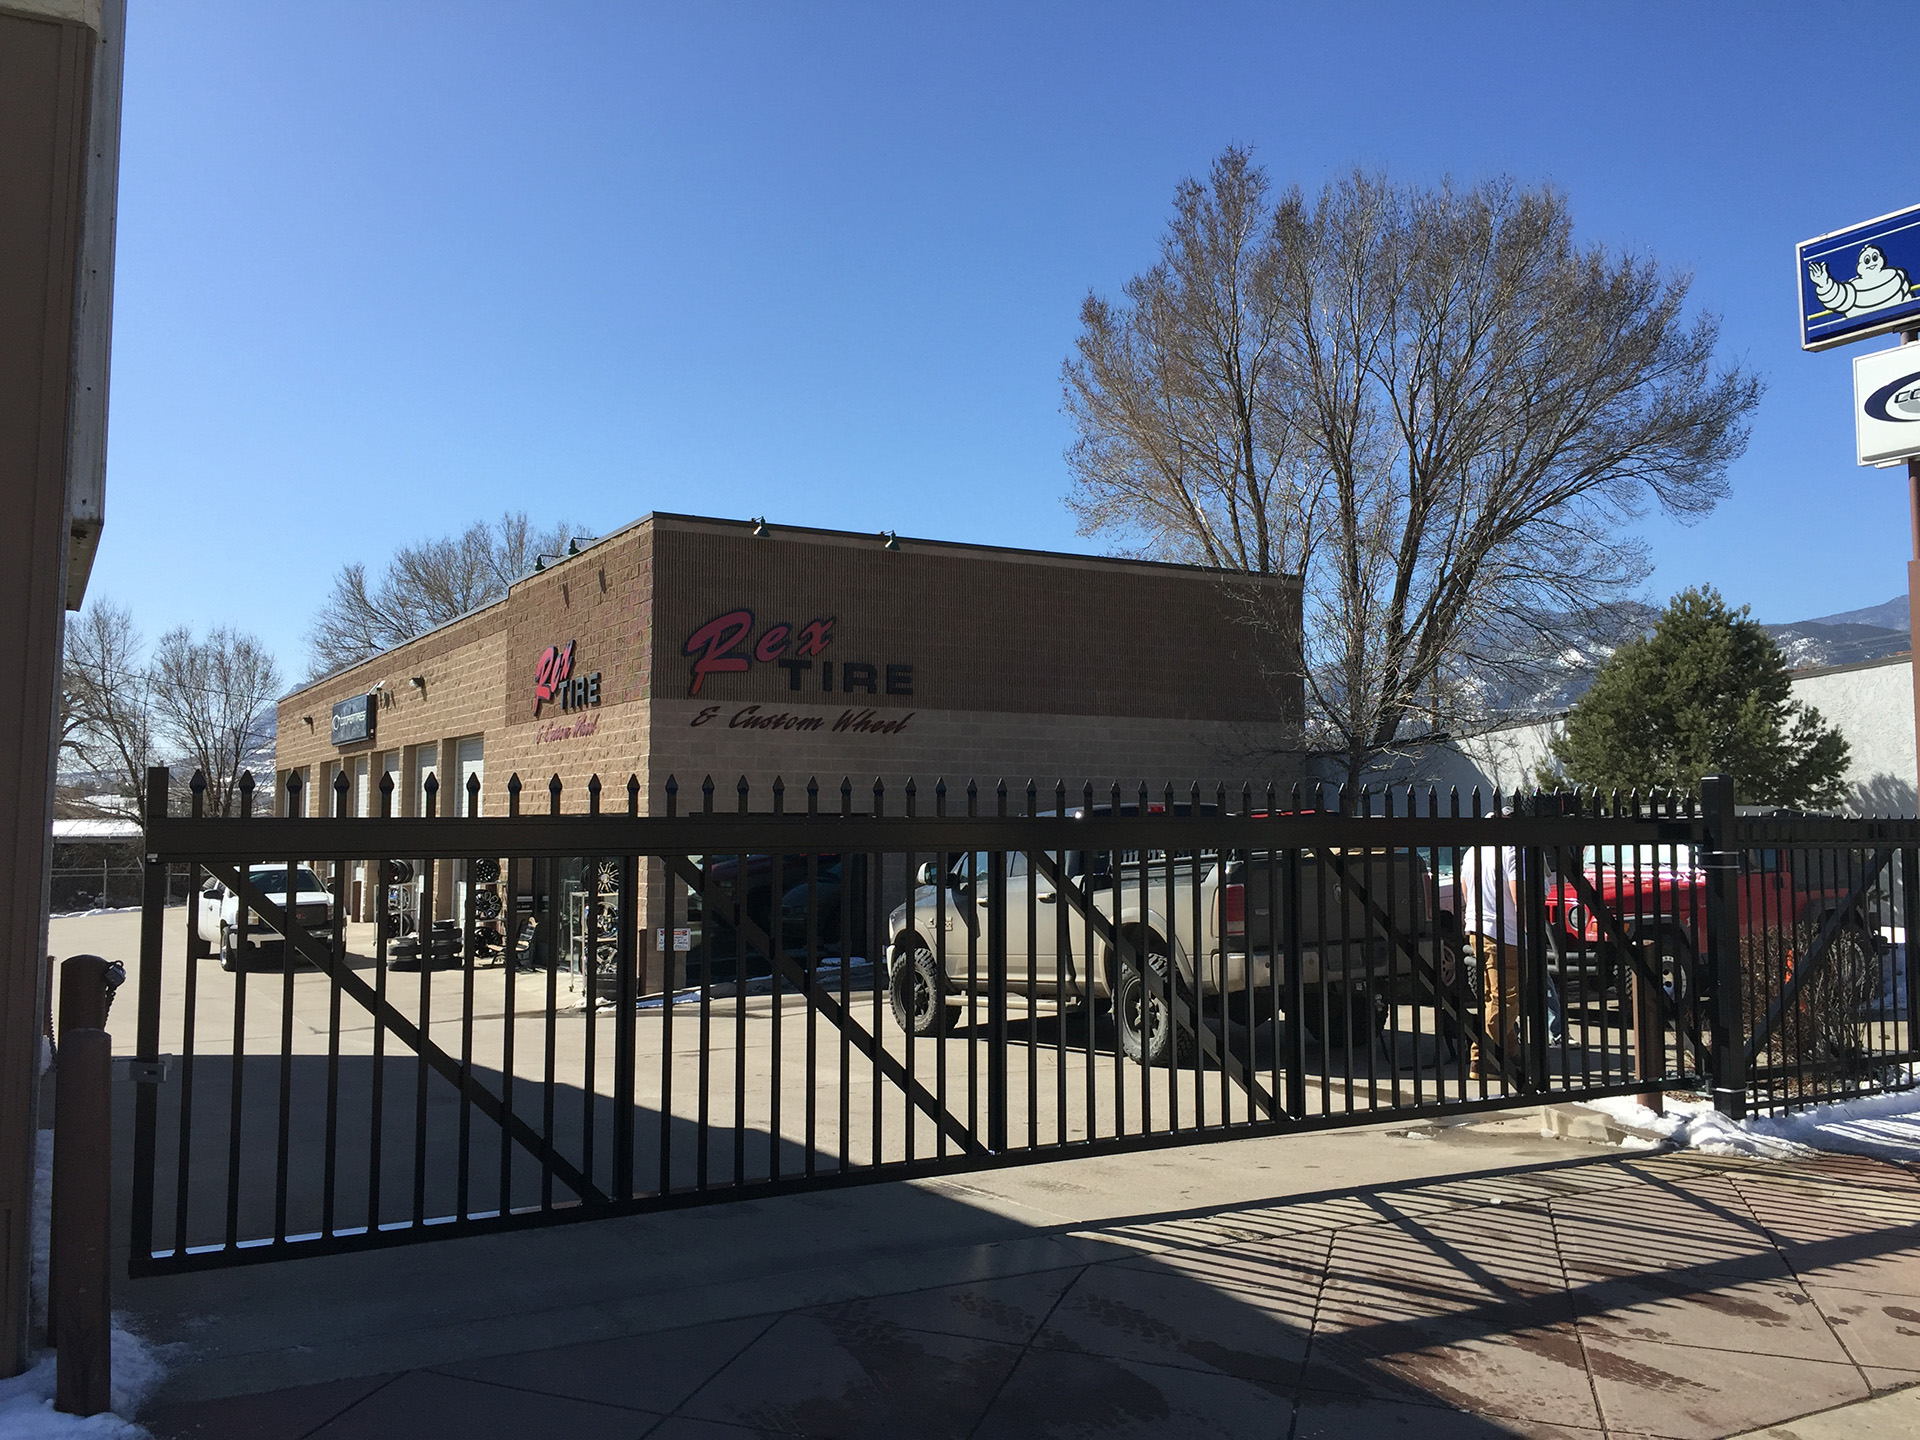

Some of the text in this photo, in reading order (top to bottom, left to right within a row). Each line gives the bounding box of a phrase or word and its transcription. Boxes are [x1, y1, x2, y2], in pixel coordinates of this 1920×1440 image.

[683, 608, 836, 697] Rex
[559, 672, 601, 709] TIRE
[779, 659, 914, 696] TIRE
[728, 705, 824, 731] Custom
[831, 708, 916, 735] Wheel
